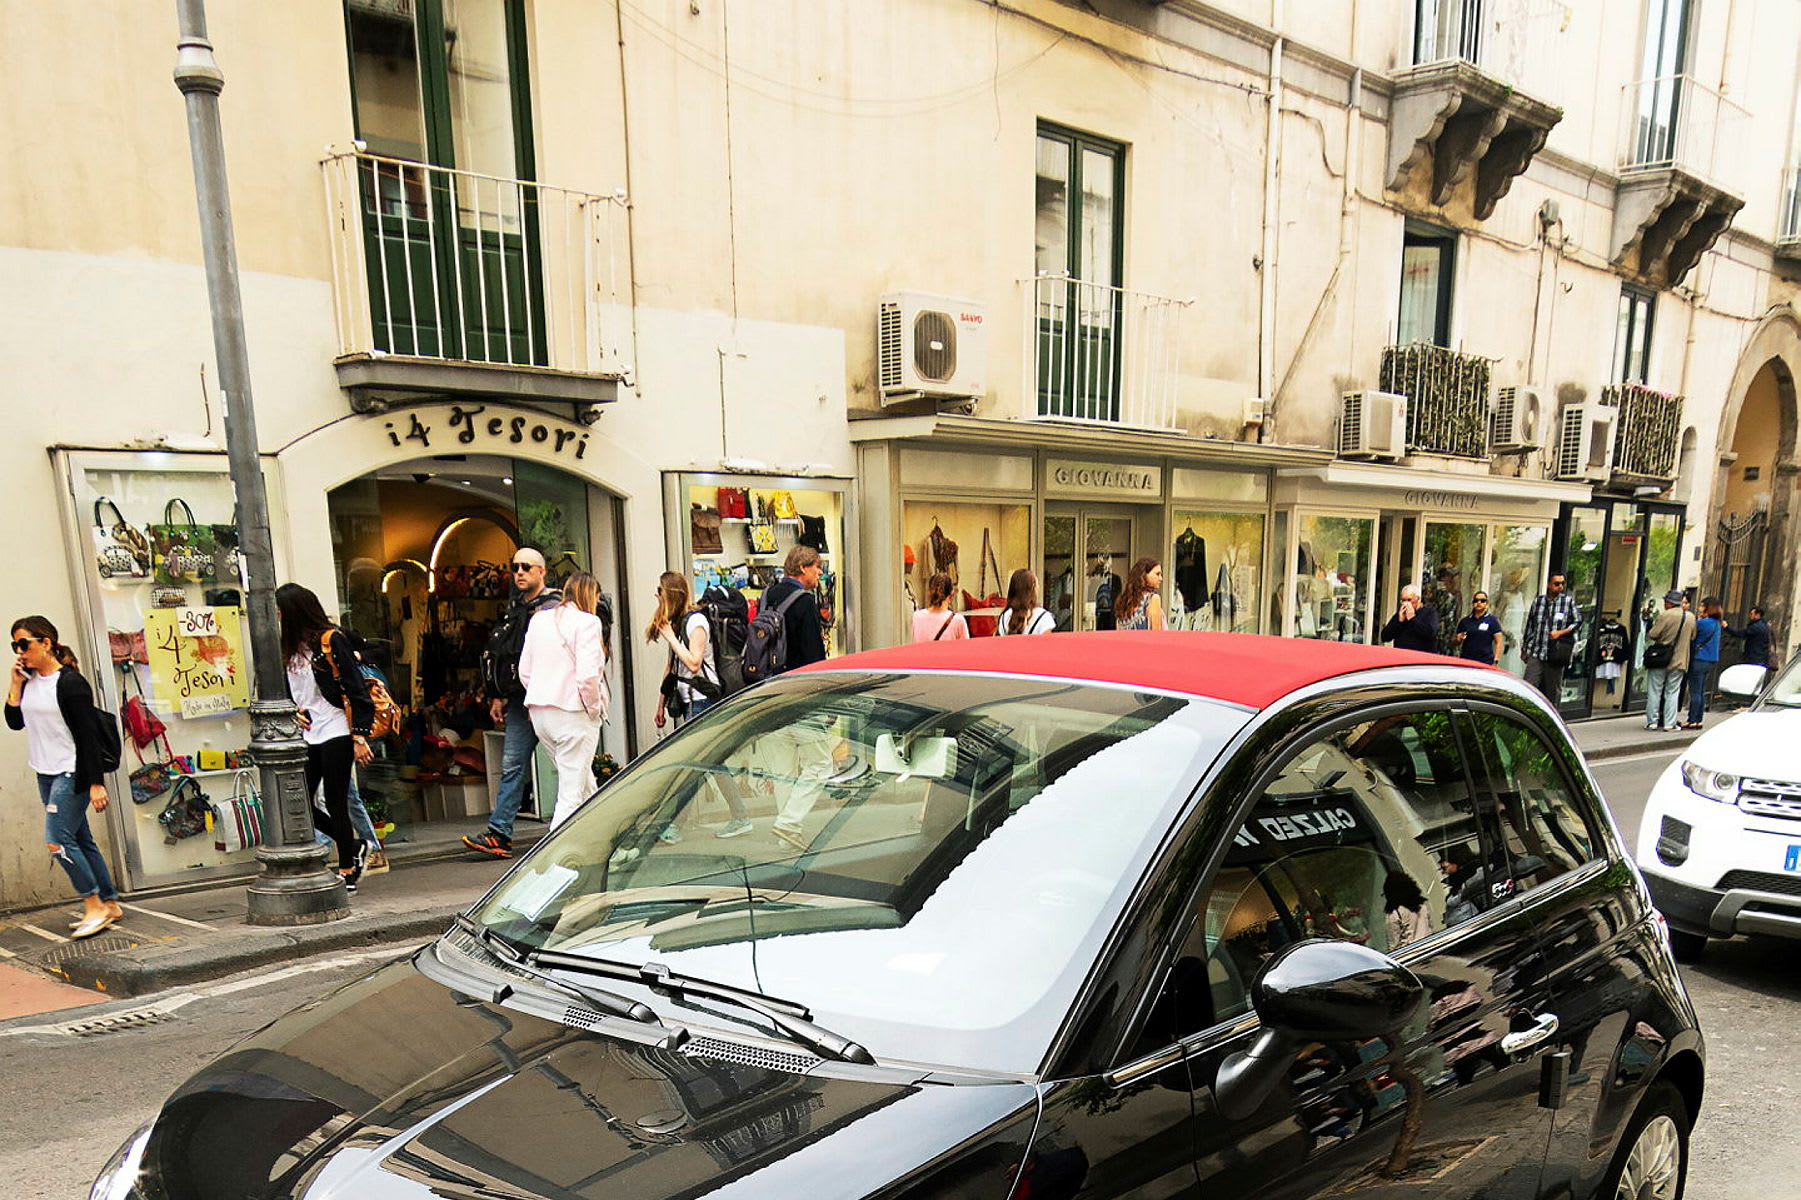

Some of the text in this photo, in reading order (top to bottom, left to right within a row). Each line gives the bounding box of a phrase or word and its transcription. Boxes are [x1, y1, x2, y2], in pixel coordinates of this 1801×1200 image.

[449, 406, 590, 459] Tesori
[1055, 467, 1153, 490] GIOVANNA
[1404, 489, 1479, 509] GIOVANNA
[178, 610, 215, 632] -30%
